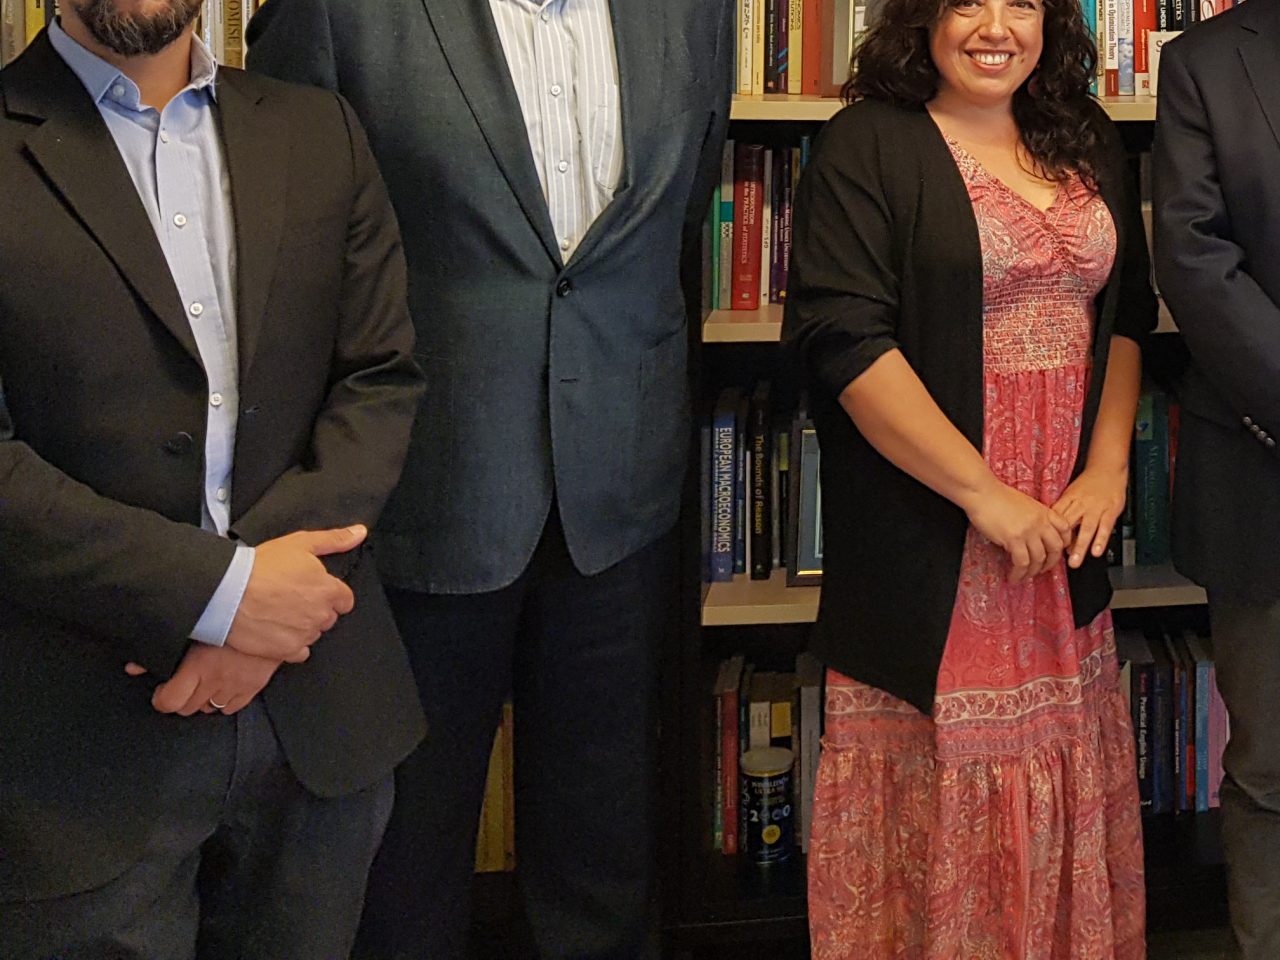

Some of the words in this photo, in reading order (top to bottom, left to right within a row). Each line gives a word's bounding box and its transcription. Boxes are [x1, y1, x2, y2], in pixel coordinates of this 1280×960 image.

[1108, 10, 1116, 41] Optimization
[1108, 43, 1116, 60] Theory
[719, 427, 732, 472] EUROPEAN
[755, 435, 764, 452] The
[755, 453, 764, 487] Bounds
[755, 489, 764, 499] of
[717, 473, 731, 553] MACROECONOMICS
[755, 500, 764, 534] Reason
[1139, 729, 1147, 755] English
[1139, 757, 1147, 779] Usage
